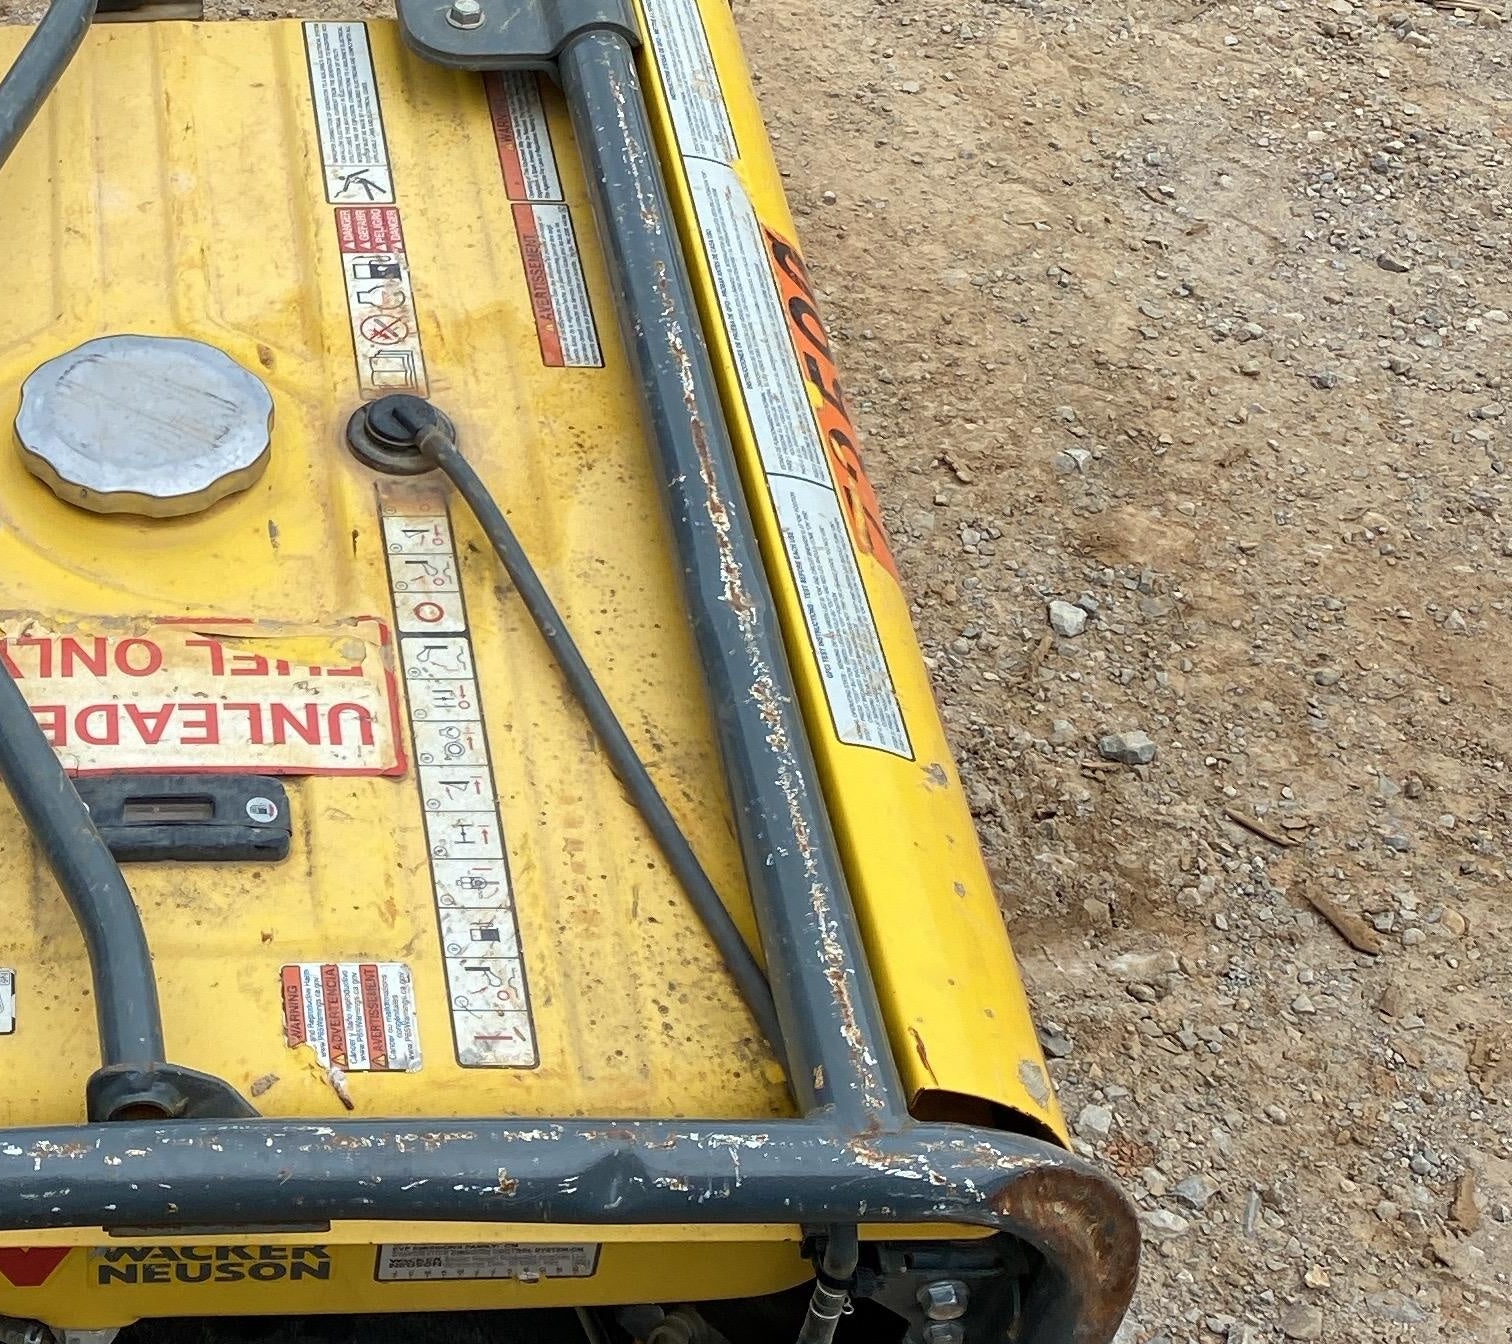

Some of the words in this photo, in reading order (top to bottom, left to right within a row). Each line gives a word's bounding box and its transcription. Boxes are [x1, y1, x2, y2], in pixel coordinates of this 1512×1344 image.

[340, 210, 353, 241] DANGER
[371, 209, 385, 243] PELIGRO
[386, 210, 400, 241] DANGER
[523, 233, 552, 321] AVERTISSEMENT
[186, 639, 365, 678] EL
[30, 703, 376, 747] UNLEADE
[325, 968, 344, 1051] ADVERTENCIA
[364, 968, 384, 1051] AVERTISSEMENT
[102, 1245, 331, 1262] WACKER
[98, 1260, 331, 1285] NEUSON
